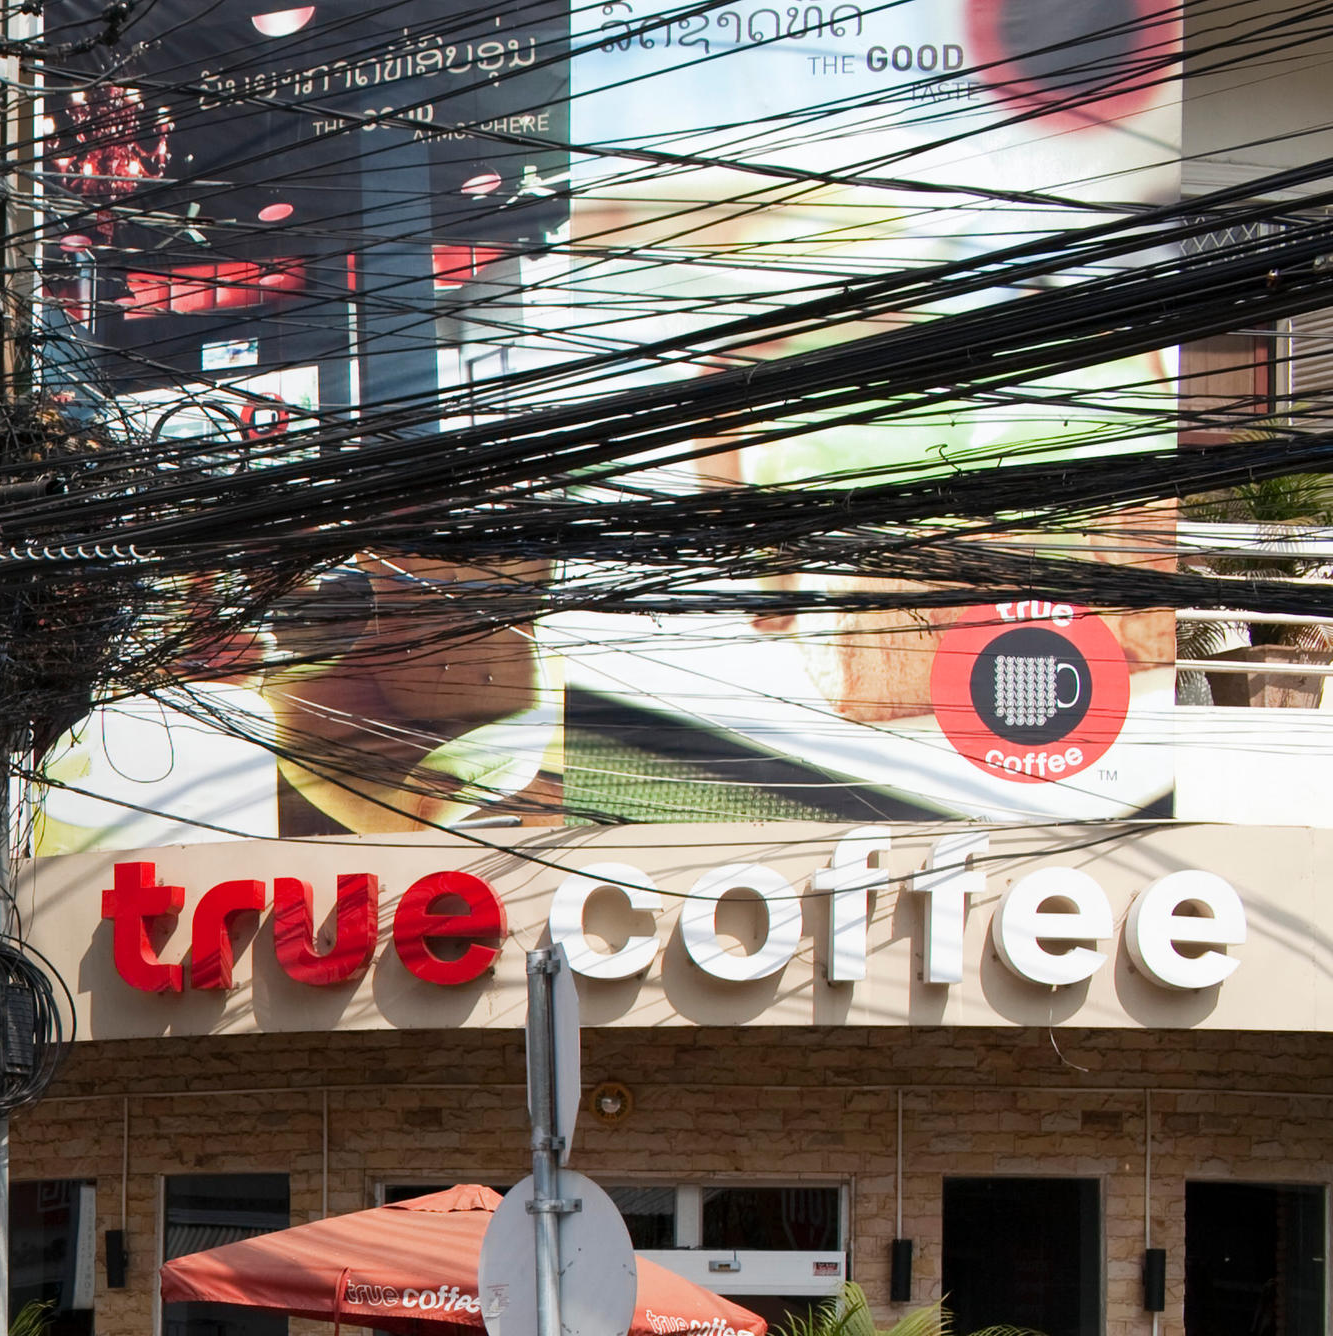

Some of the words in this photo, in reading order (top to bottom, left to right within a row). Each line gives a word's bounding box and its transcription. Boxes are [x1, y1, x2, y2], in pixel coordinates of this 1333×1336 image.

[808, 56, 855, 76] THE
[866, 44, 964, 73] GOOD
[910, 80, 981, 102] TASTE
[994, 600, 1074, 627] true
[984, 747, 1084, 777] coffee
[1098, 770, 1118, 781] TM
[101, 861, 507, 994] true
[549, 827, 1249, 990] coffee
[345, 1279, 400, 1307] true
[402, 1285, 482, 1313] coffee
[646, 1309, 689, 1335] true
